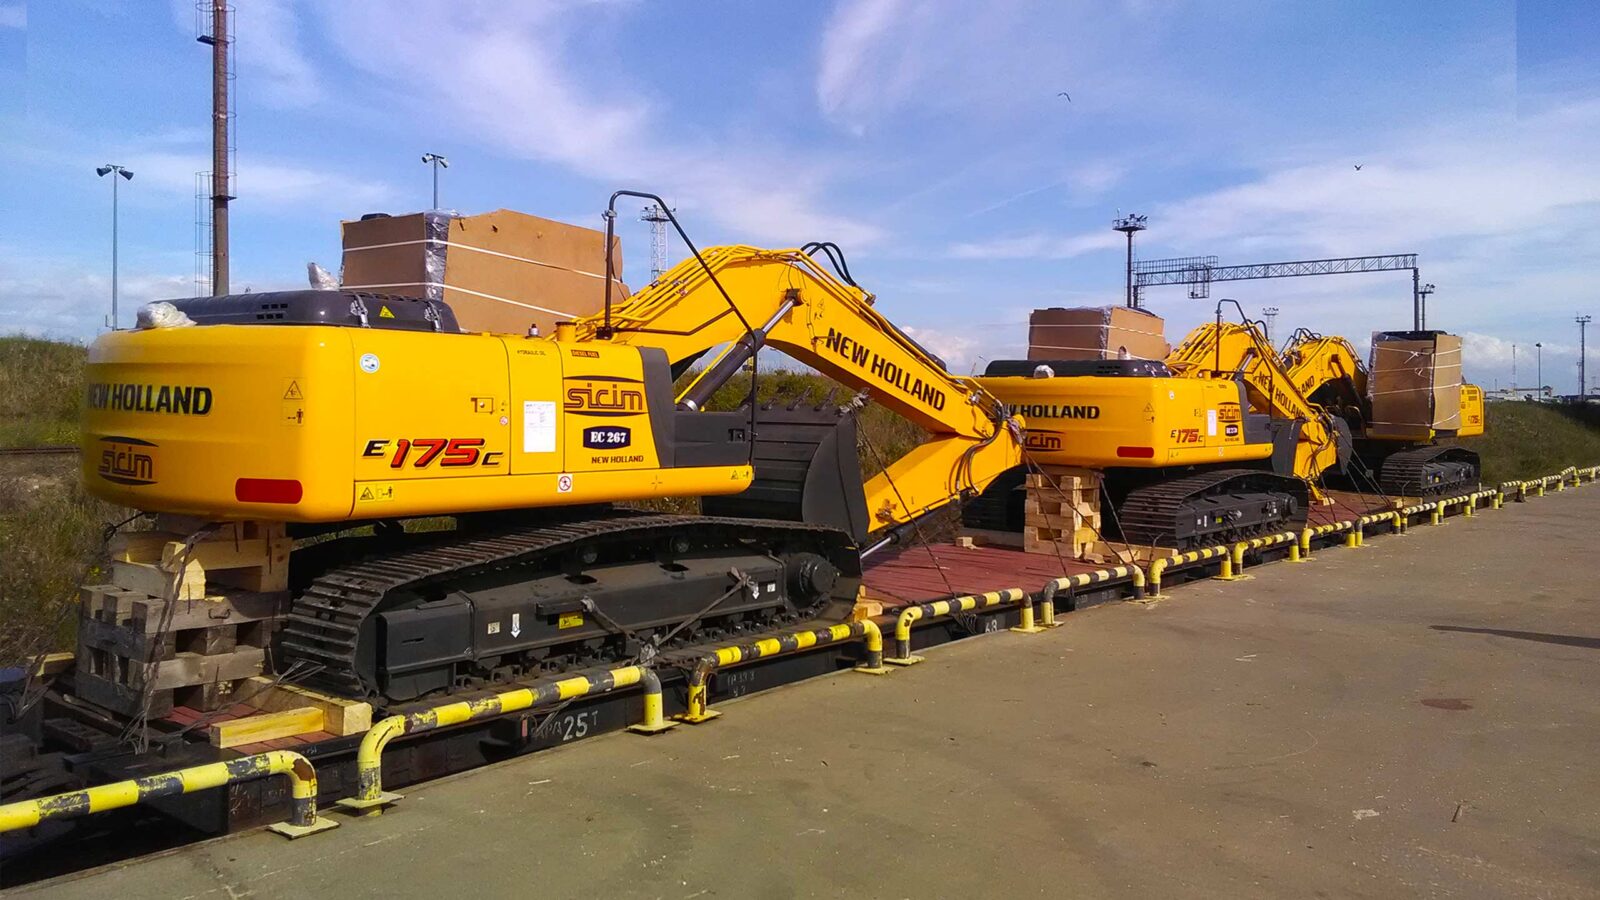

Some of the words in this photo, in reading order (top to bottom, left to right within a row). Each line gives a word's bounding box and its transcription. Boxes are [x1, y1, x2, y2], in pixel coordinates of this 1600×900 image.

[826, 327, 870, 368] NEW
[870, 354, 946, 412] HOLLAND
[112, 384, 212, 415] HOLLAND
[564, 383, 642, 410] sicim
[1020, 405, 1100, 419] HOLLAND
[590, 431, 605, 443] EC
[606, 432, 627, 443] 267
[98, 443, 153, 479] sicim
[591, 456, 609, 464] NEW
[610, 455, 643, 463] HOLLAND
[562, 713, 588, 741] 25
